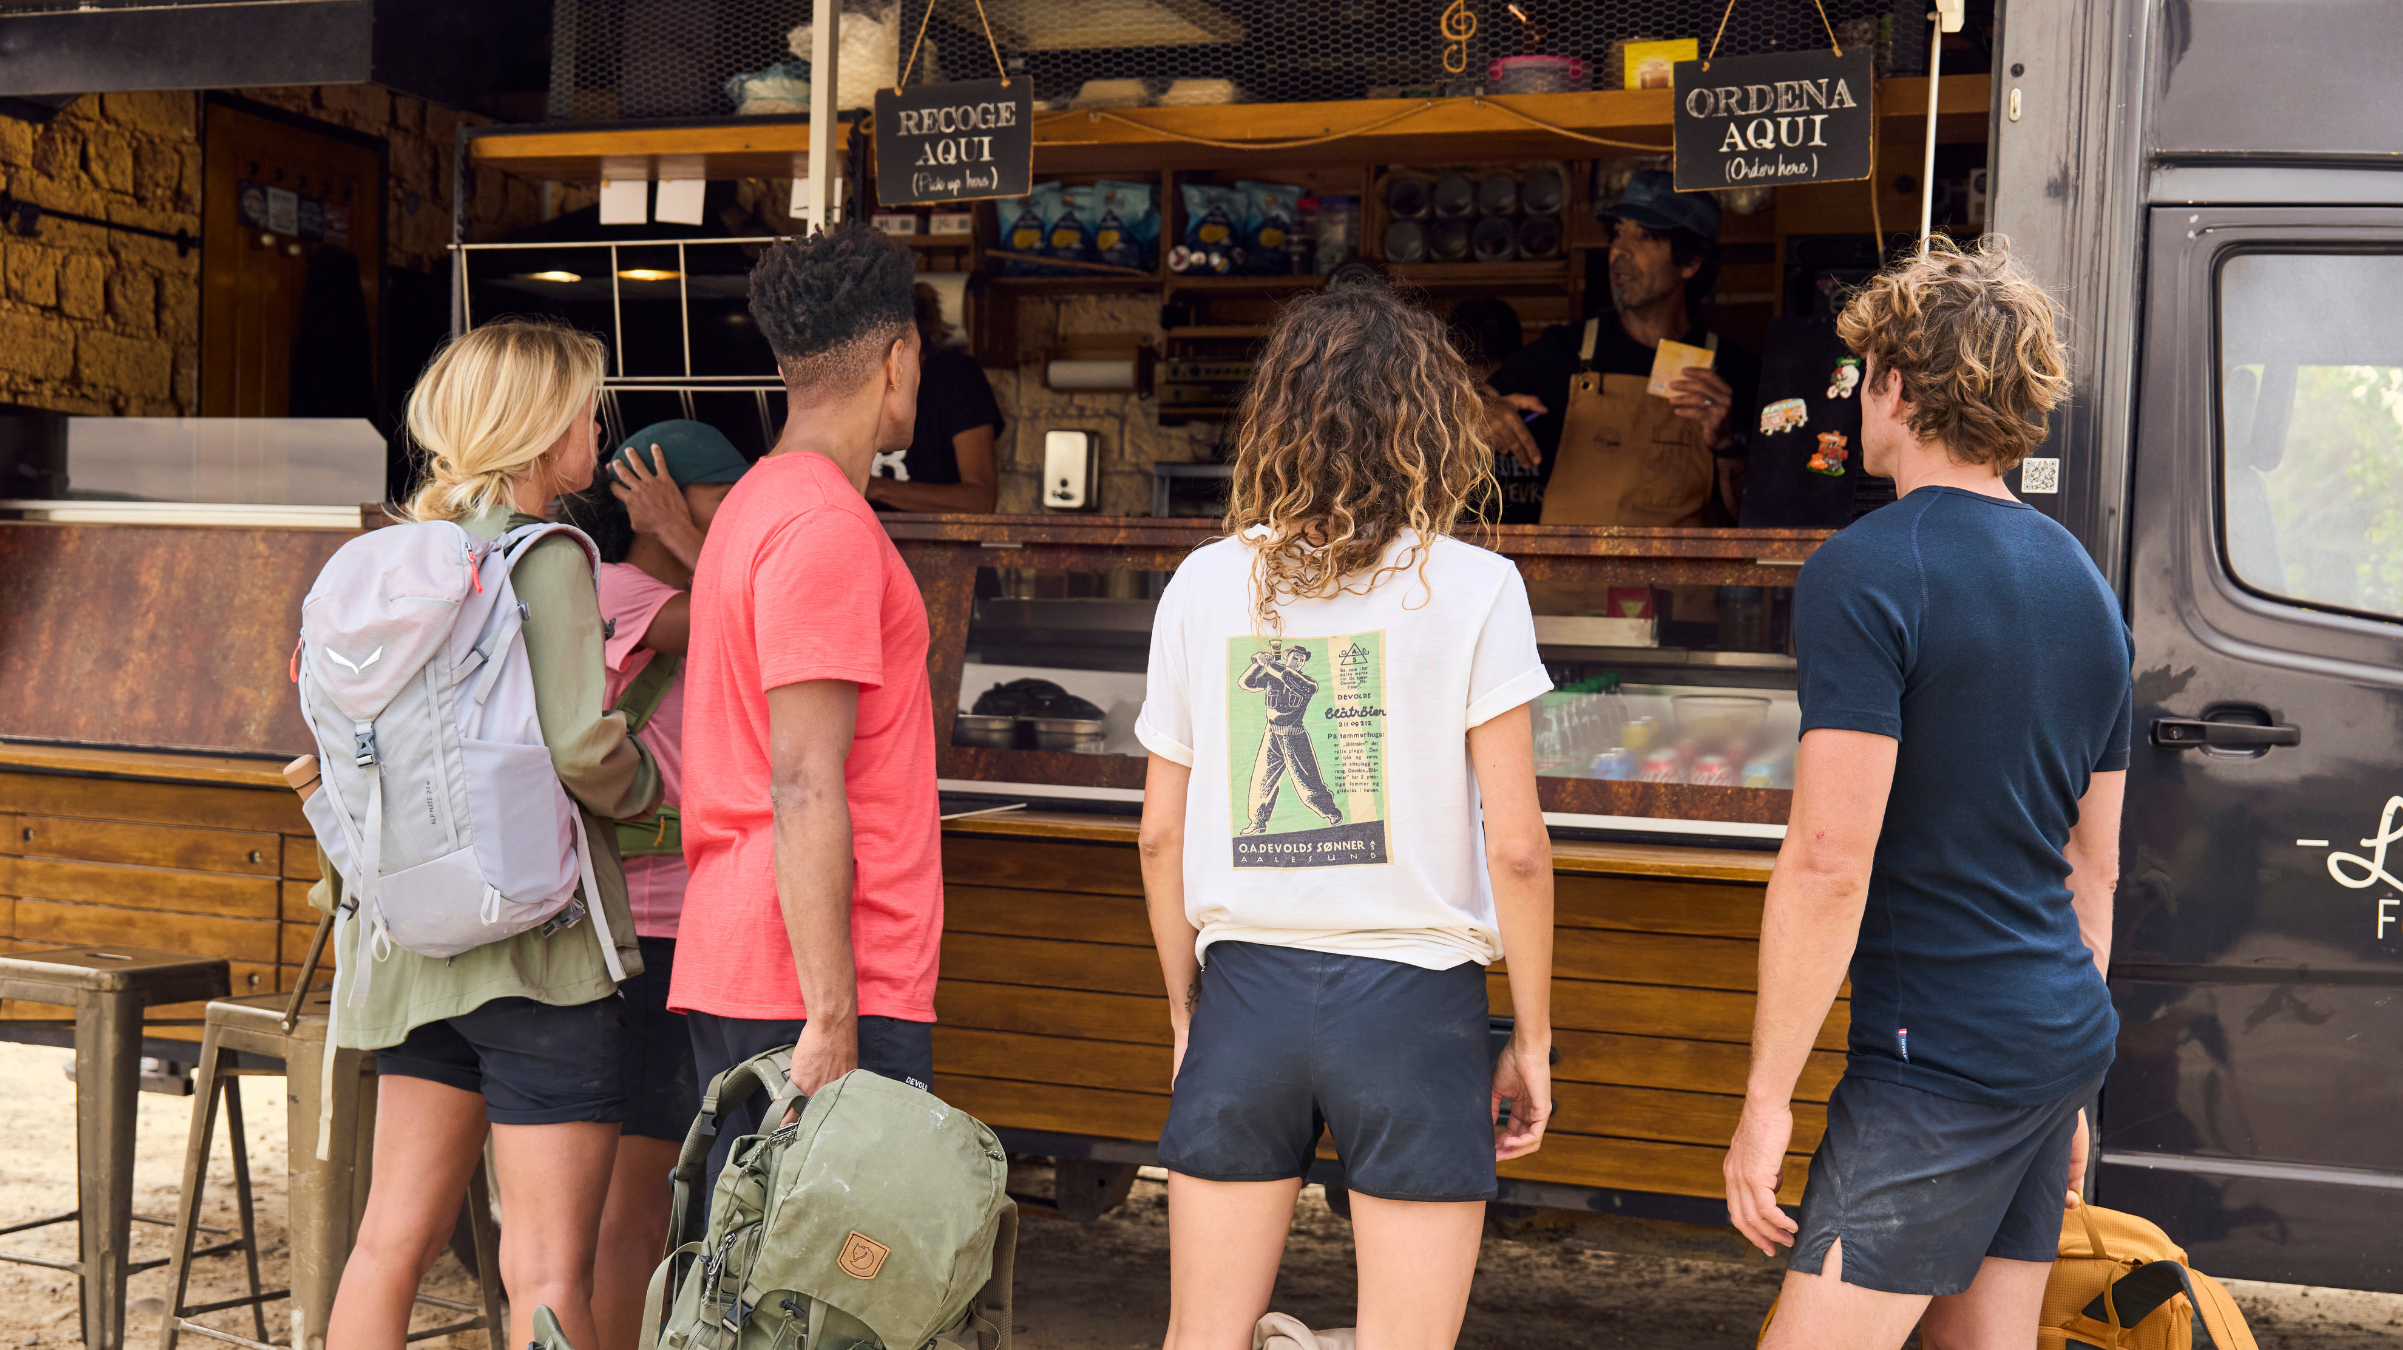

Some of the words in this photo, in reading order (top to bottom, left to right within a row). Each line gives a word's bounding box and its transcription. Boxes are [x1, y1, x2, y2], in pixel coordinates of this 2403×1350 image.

[1686, 77, 1857, 118] ORDENA
[897, 101, 1016, 136] RECOGE
[1719, 114, 1829, 152] AQUI
[915, 136, 994, 166] AQUI
[1317, 840, 1365, 851] SØNNER
